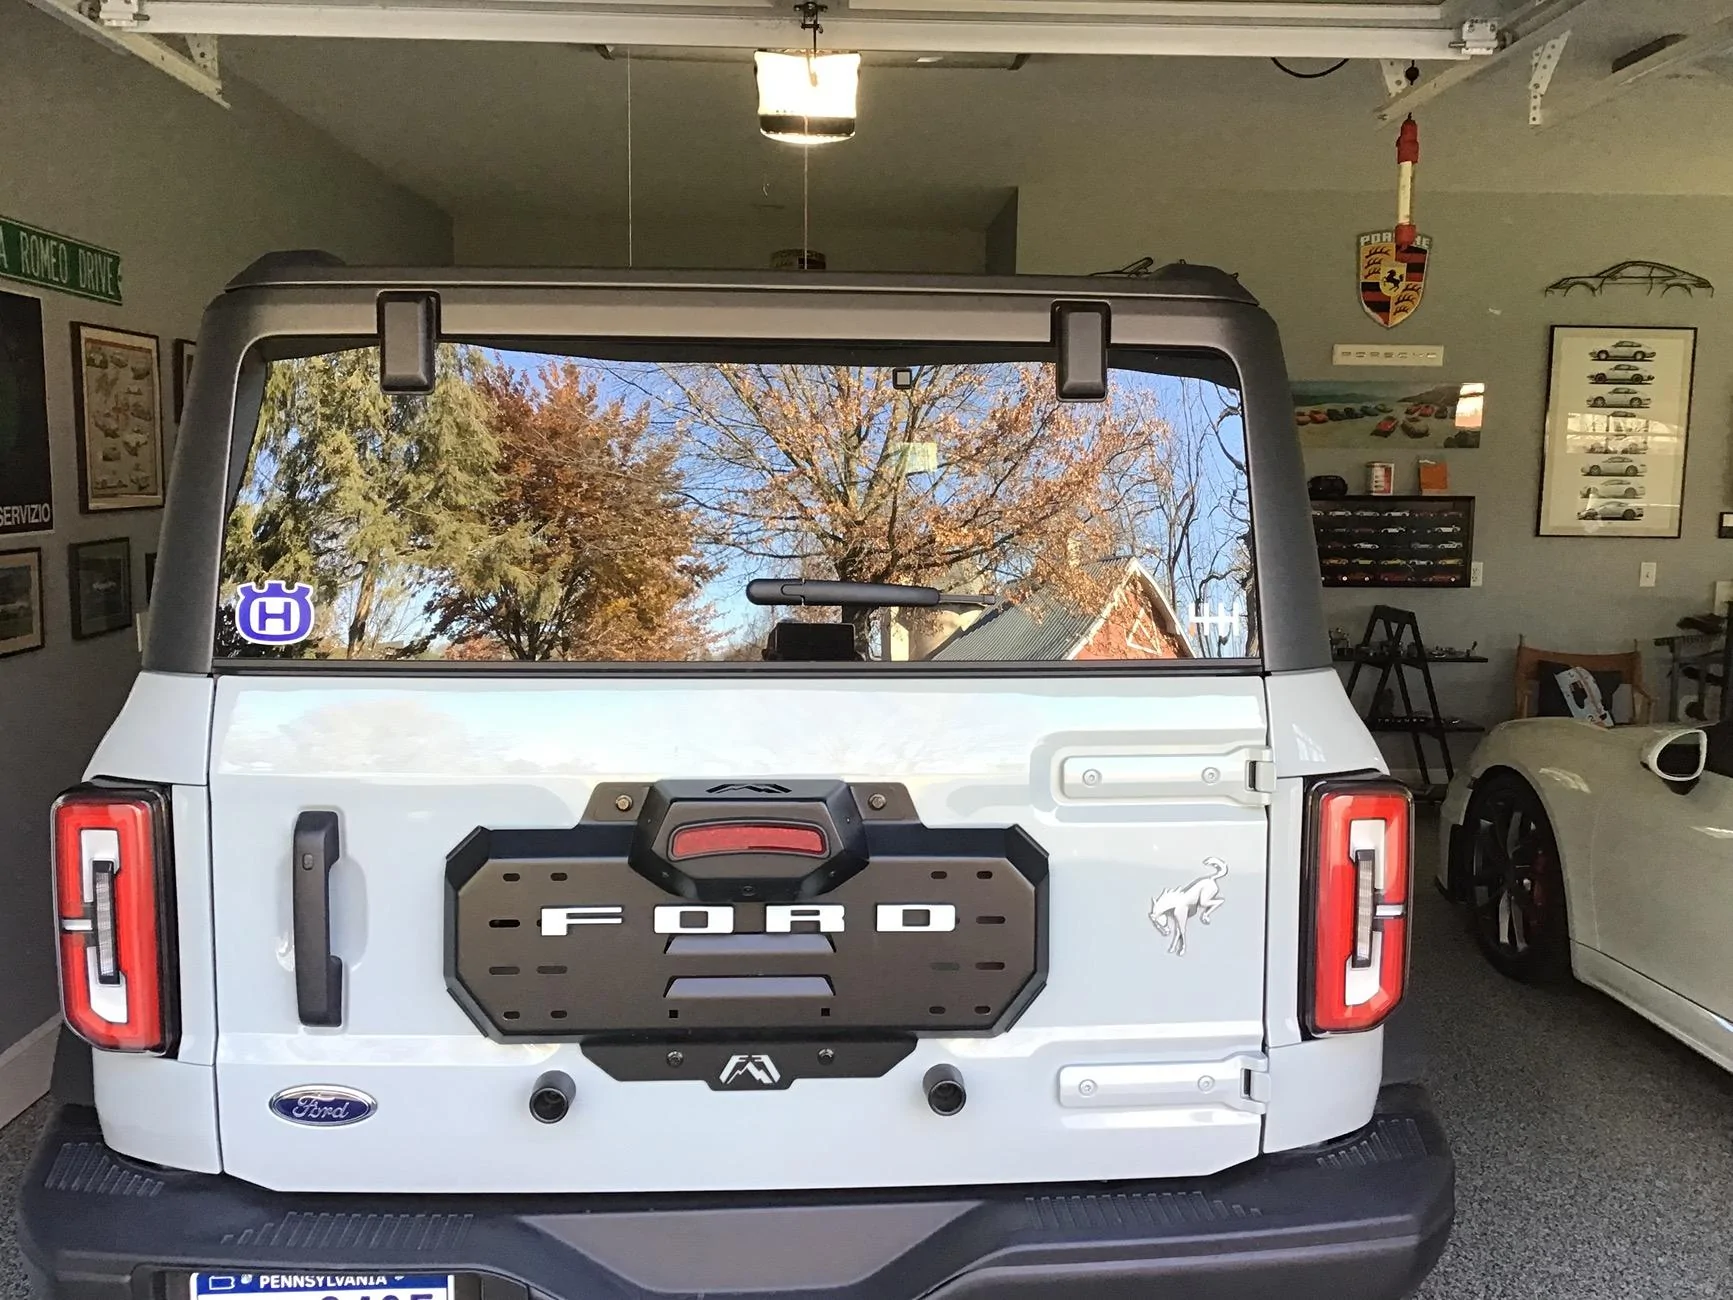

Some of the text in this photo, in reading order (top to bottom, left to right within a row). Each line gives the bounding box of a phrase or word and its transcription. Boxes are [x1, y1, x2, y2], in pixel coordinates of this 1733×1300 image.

[1361, 231, 1431, 248] PORHE
[20, 231, 68, 284] ROMEO
[79, 248, 115, 295] DRIVE
[540, 903, 956, 937] FORD
[292, 1095, 350, 1118] Ford
[259, 1275, 388, 1288] PENNSYLVANIA
